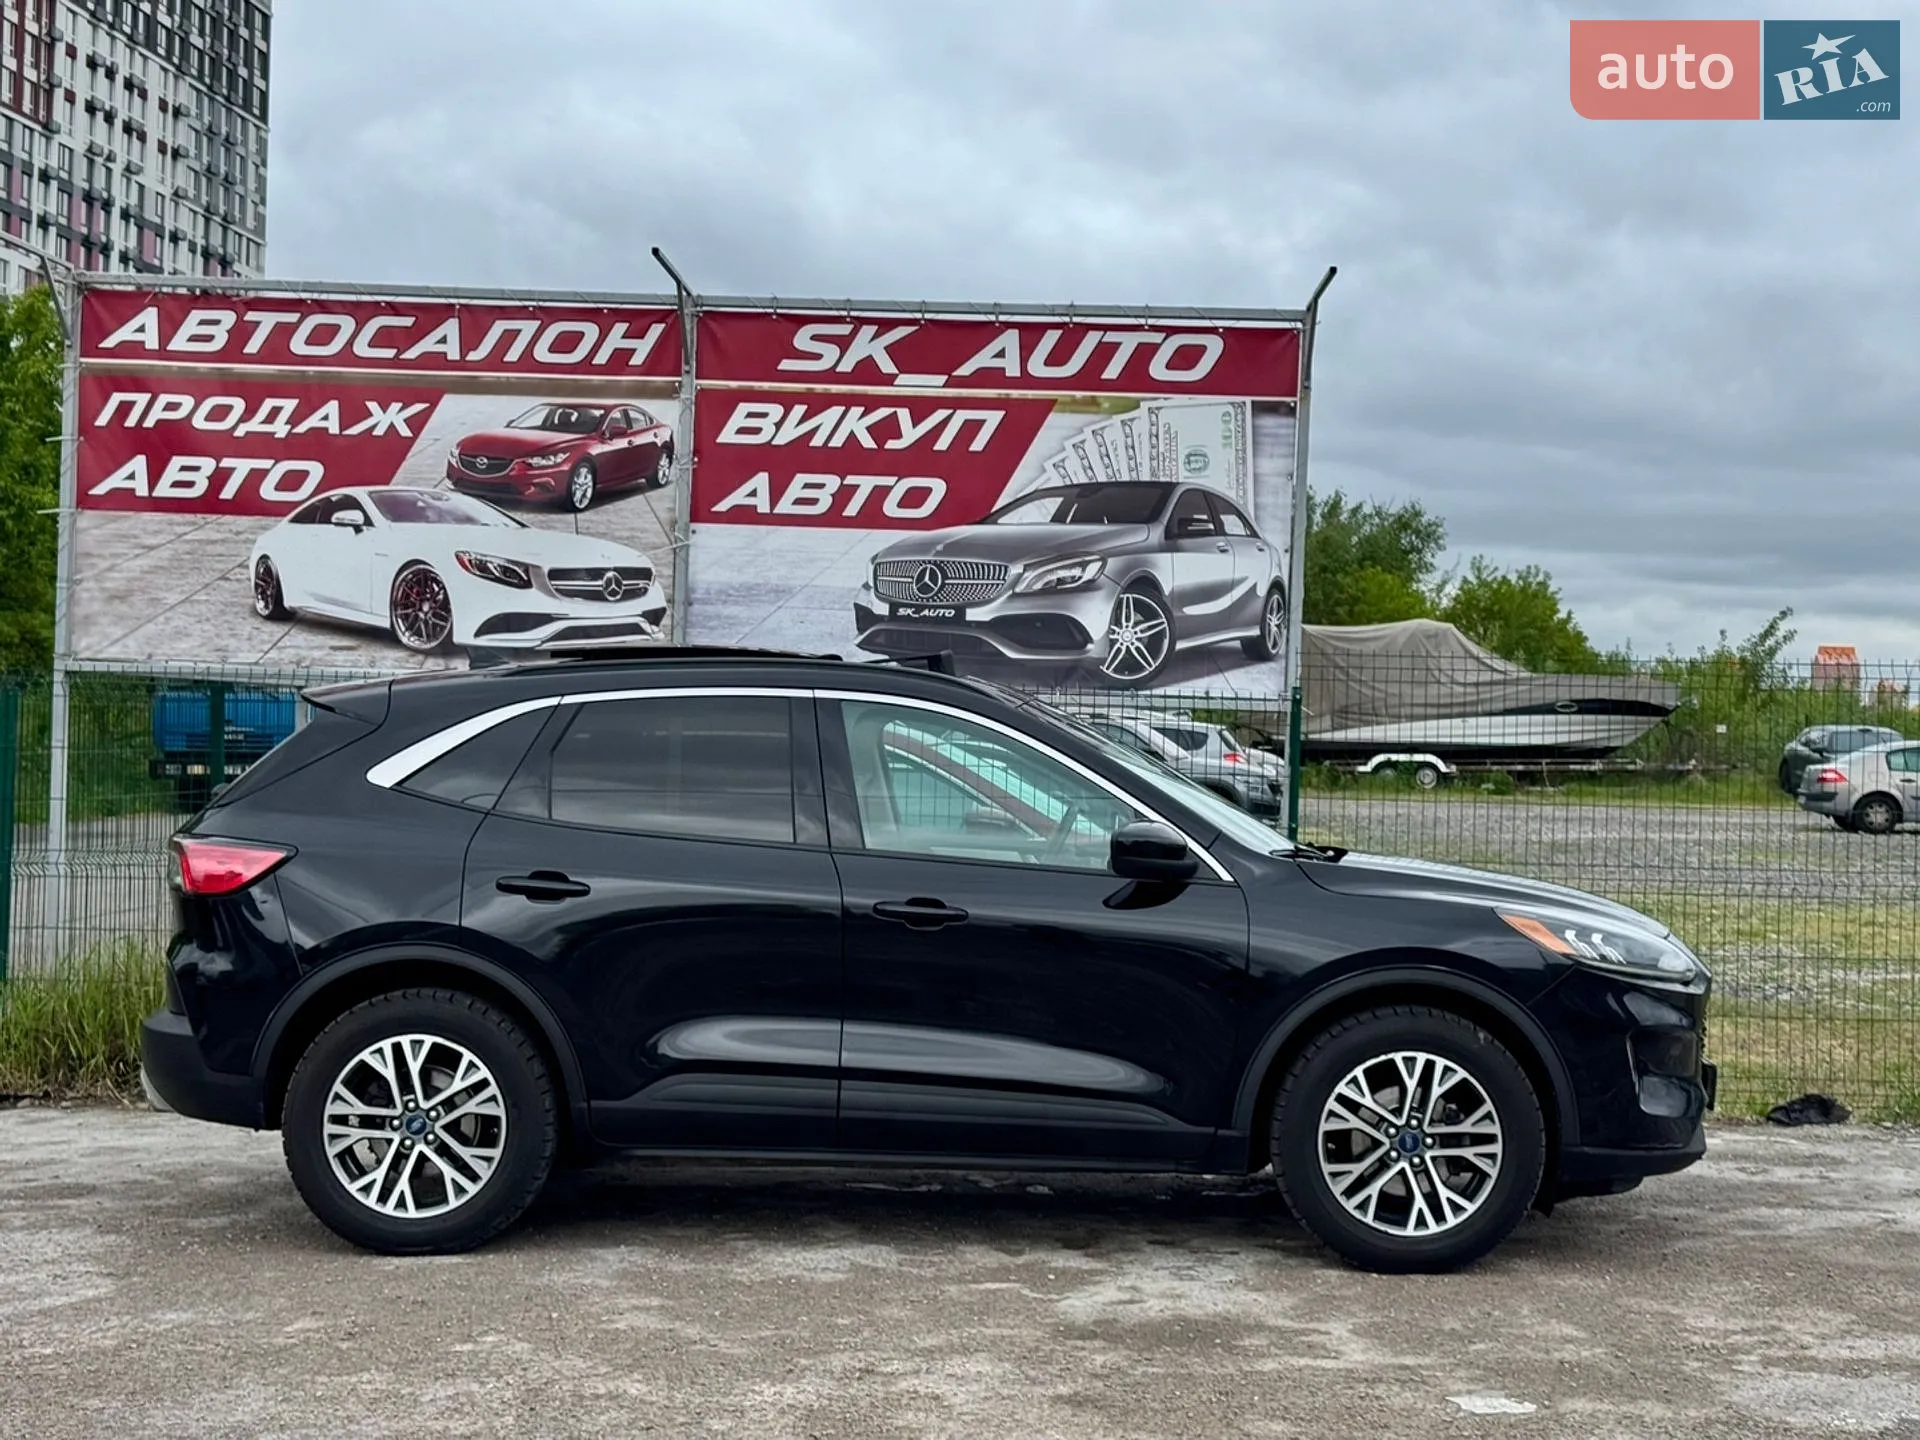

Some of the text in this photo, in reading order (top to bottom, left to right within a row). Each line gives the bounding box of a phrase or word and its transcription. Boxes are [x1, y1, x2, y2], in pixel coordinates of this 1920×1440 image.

[98, 306, 666, 366] АВТОСАЛОН
[777, 323, 1224, 387] SK_AUTO
[94, 391, 430, 438] ПРОДАЖ
[715, 402, 1006, 452] ВИКУП
[87, 454, 326, 502] АВТО
[710, 471, 947, 519] АВТО
[896, 607, 956, 618] SK_AUTO
